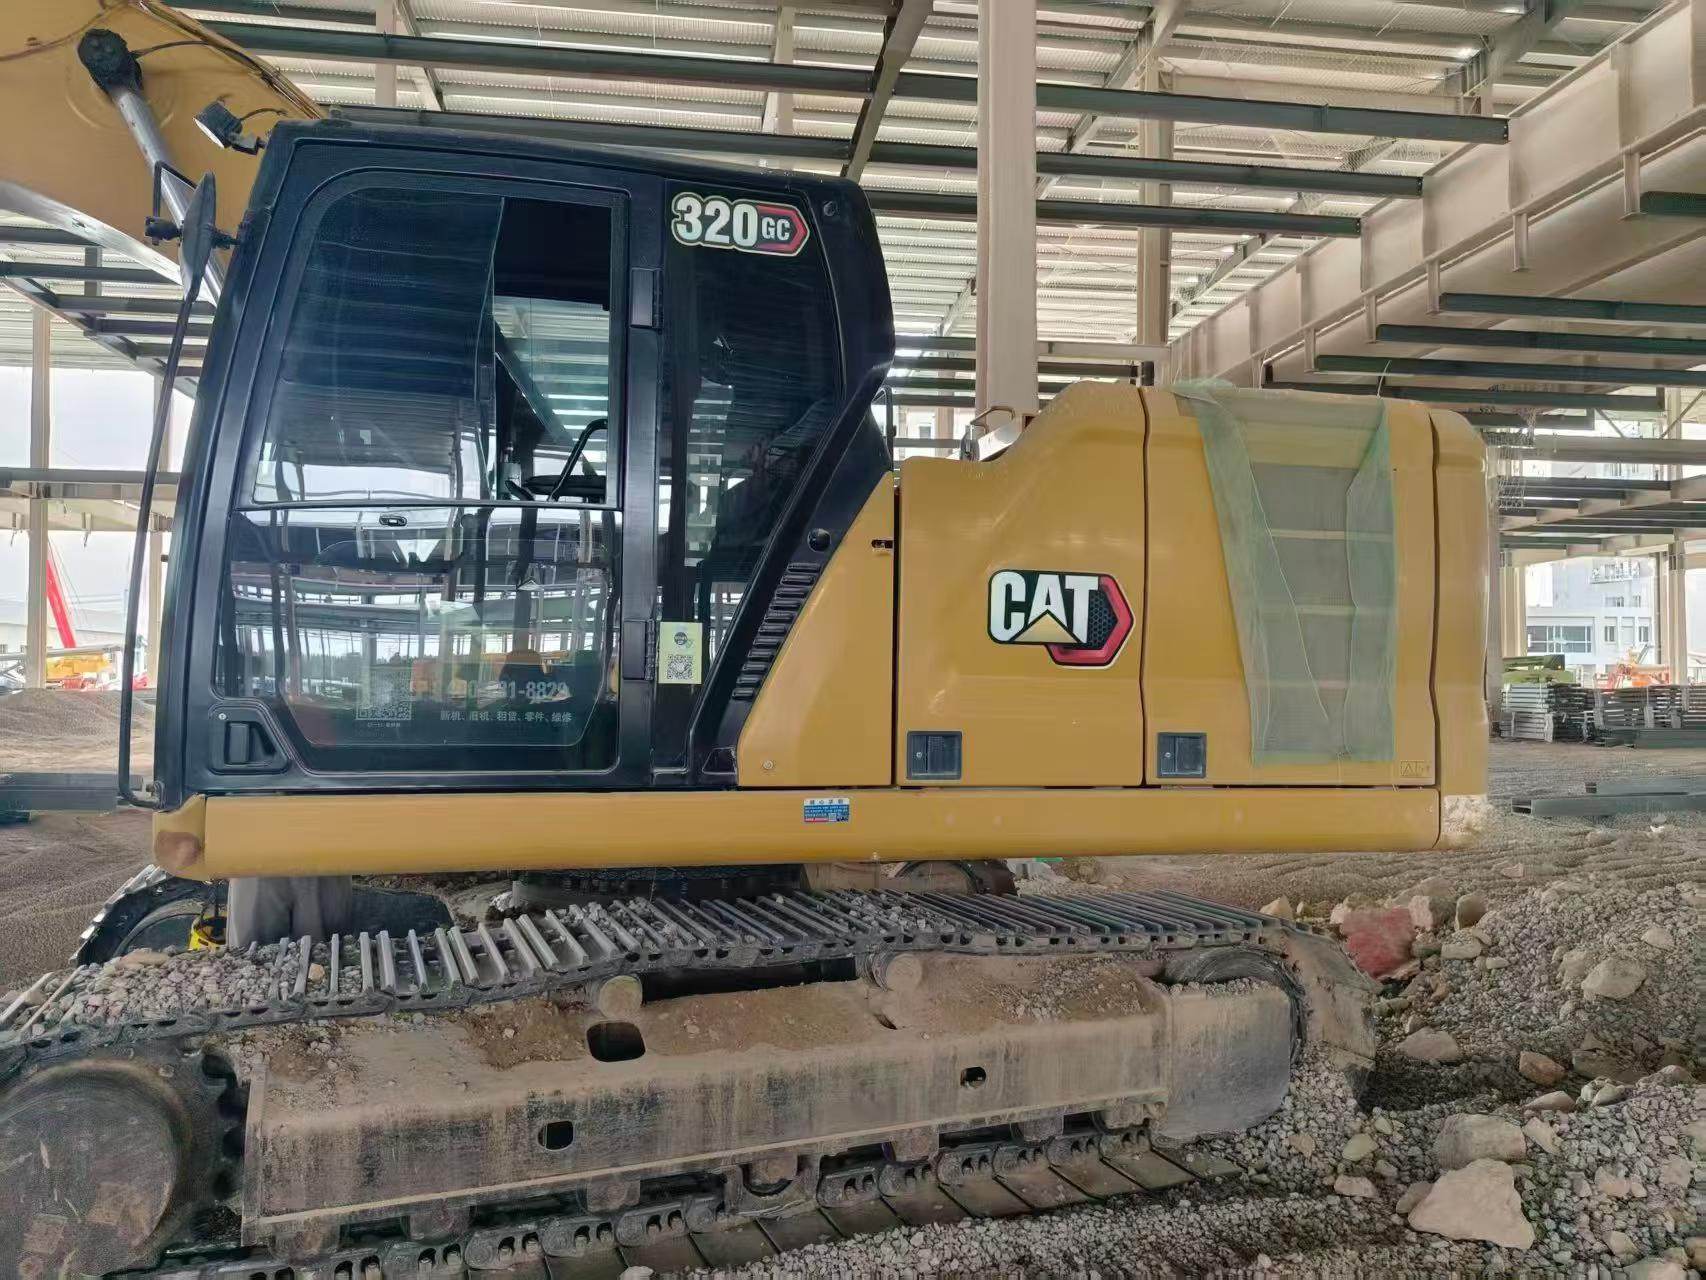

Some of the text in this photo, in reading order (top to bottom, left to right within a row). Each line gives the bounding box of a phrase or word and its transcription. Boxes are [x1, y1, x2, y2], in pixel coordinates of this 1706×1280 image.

[676, 196, 791, 247] 320 GC
[990, 570, 1099, 644] CAT
